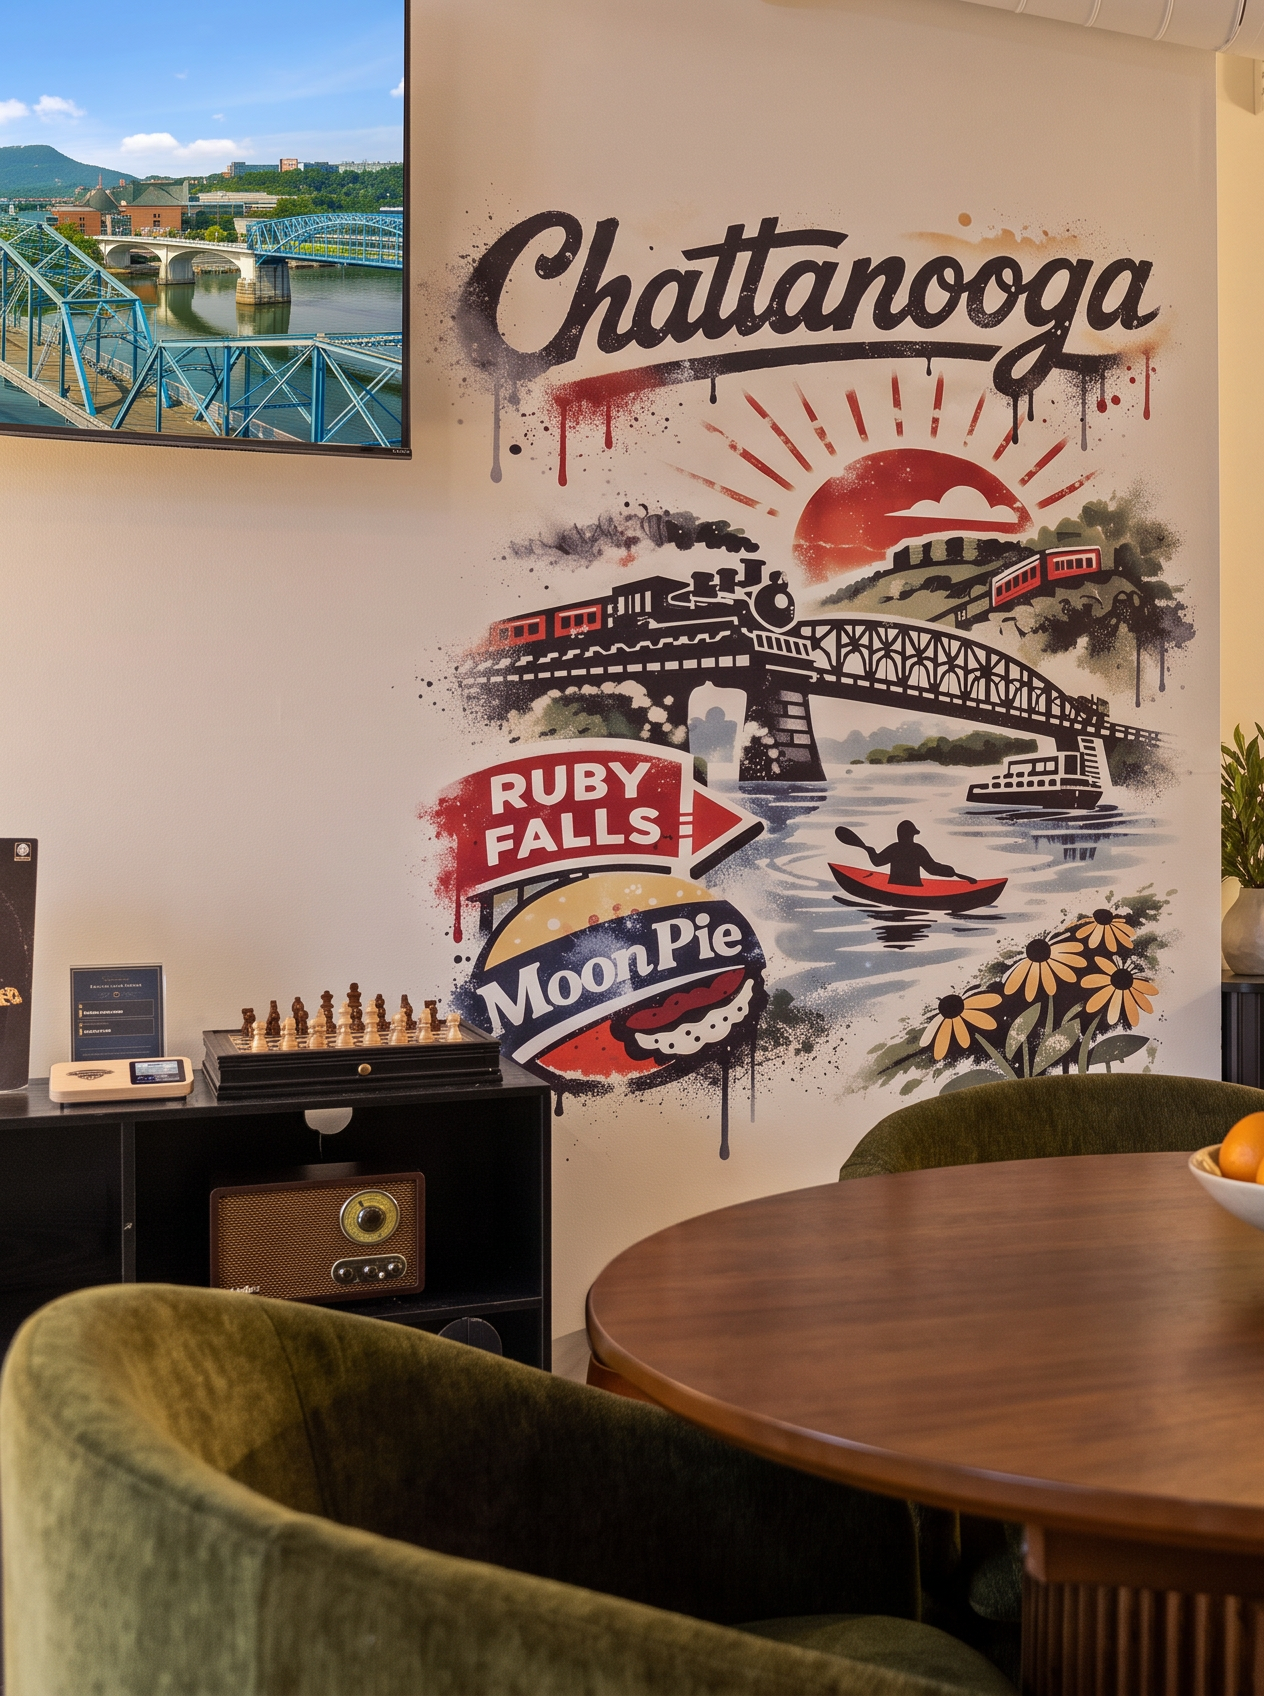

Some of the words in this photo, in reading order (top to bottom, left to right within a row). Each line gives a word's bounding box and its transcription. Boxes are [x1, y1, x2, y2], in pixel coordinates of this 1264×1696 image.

[459, 209, 1161, 399] Chattanooga
[490, 761, 652, 815] RUBY
[485, 807, 662, 867] FALLS
